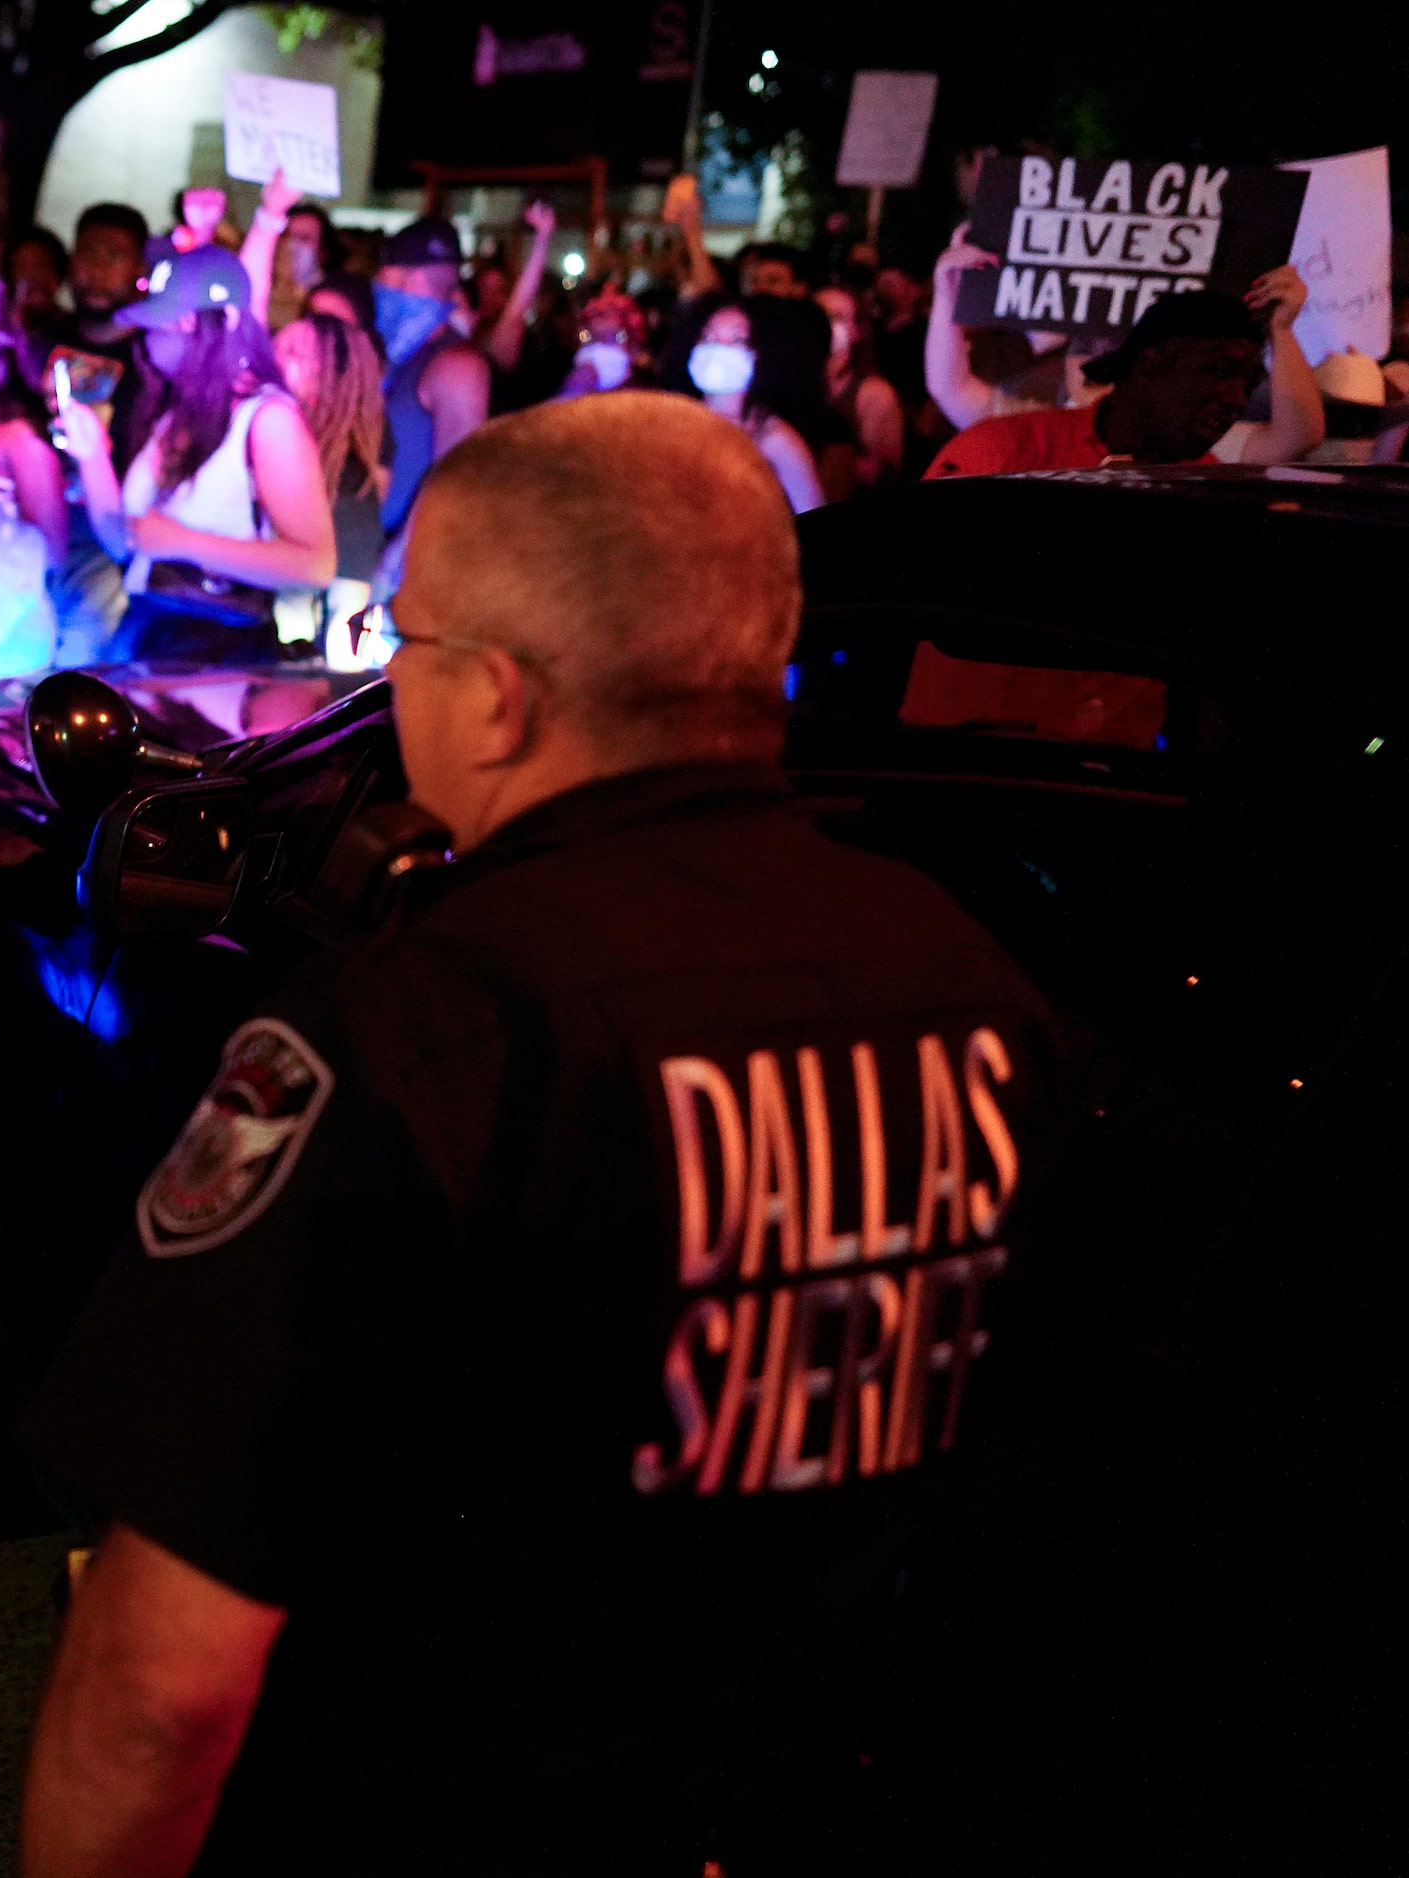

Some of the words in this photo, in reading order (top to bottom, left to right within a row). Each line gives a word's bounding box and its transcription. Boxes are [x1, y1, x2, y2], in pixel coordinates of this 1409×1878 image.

[1020, 156, 1229, 217] BLACK
[1022, 218, 1202, 266] LIVES
[661, 1028, 1019, 1286] DALLAS
[633, 1246, 1009, 1496] SHERIFF
